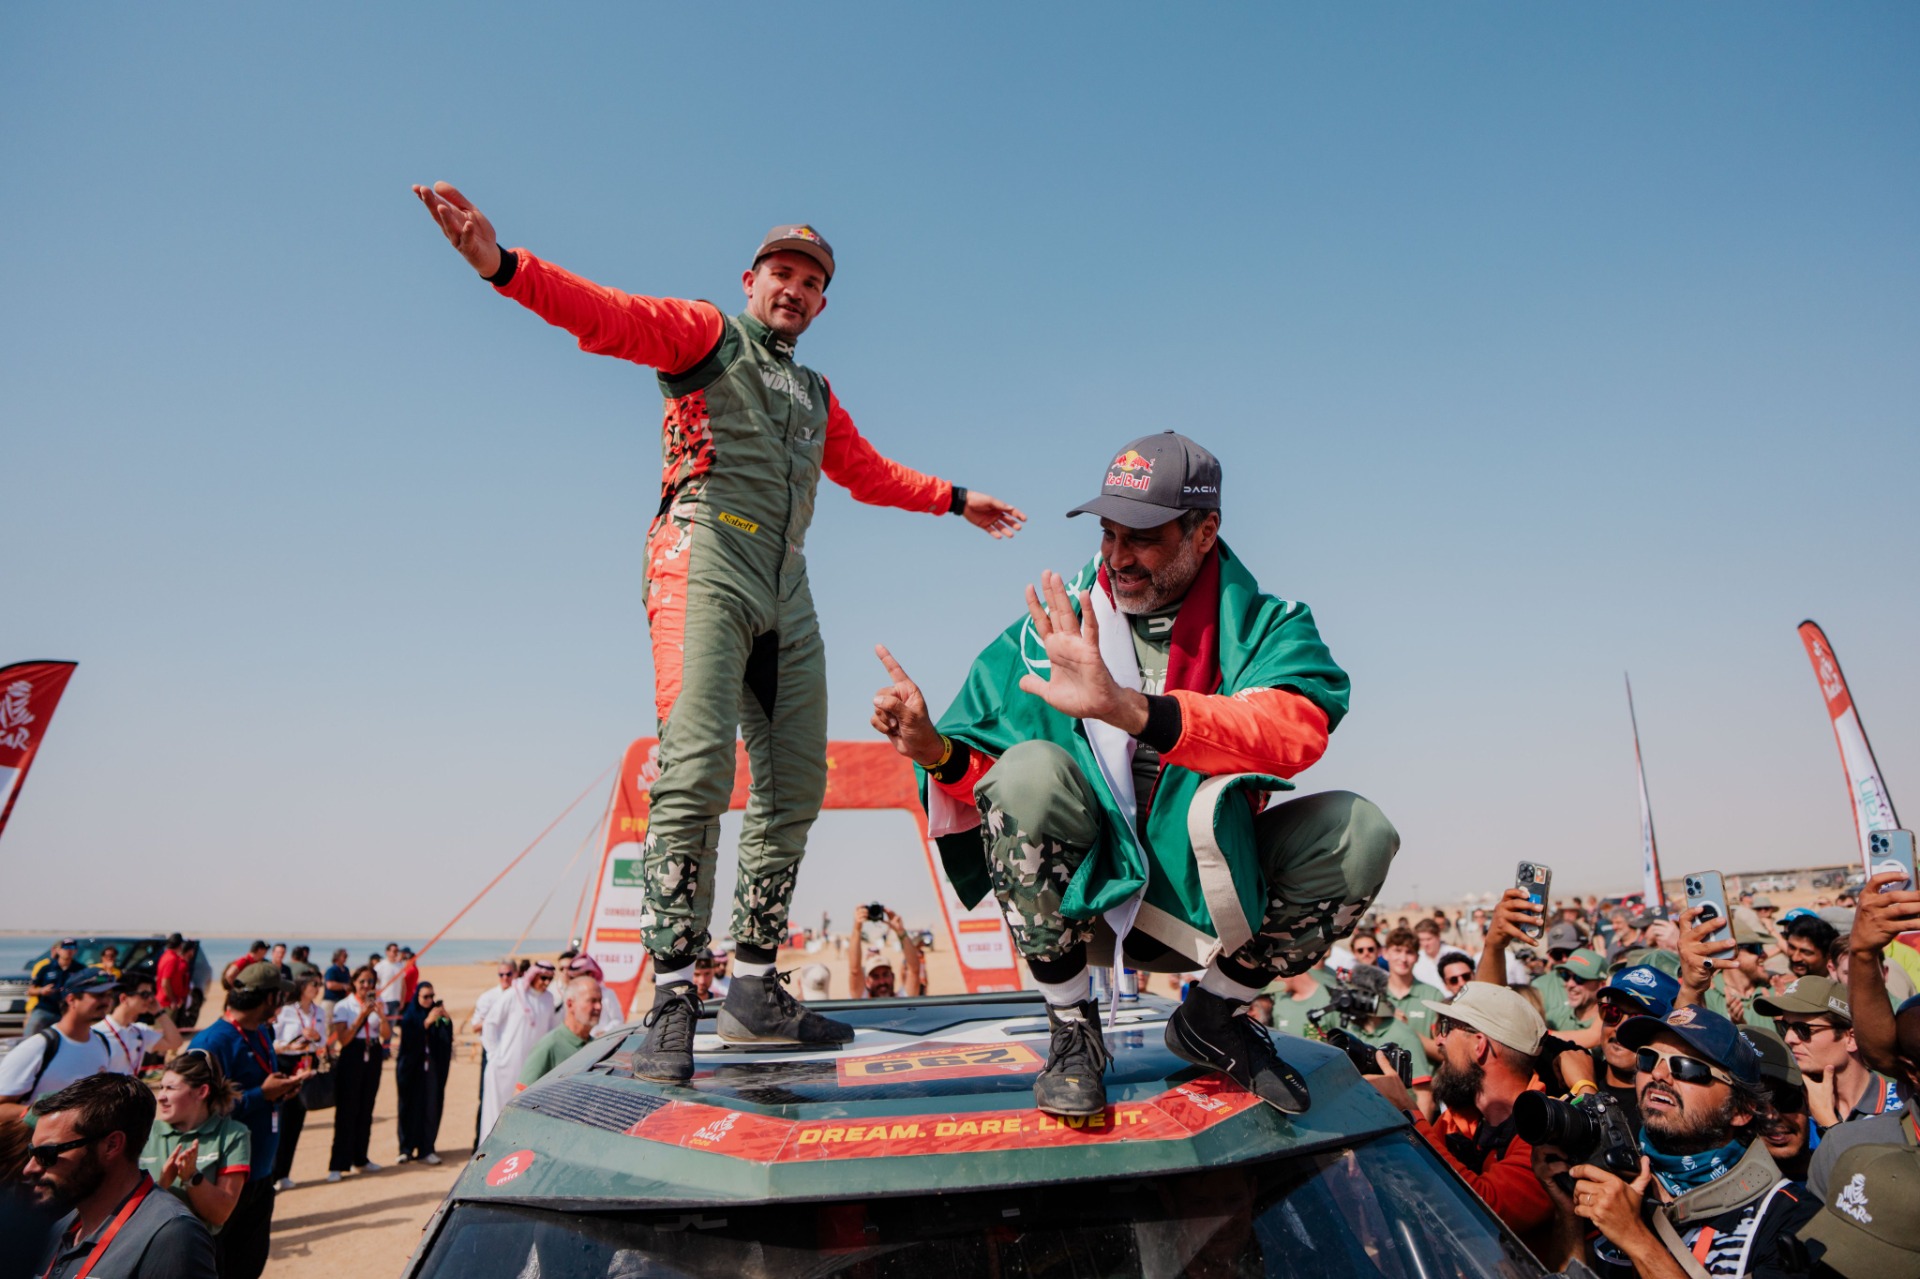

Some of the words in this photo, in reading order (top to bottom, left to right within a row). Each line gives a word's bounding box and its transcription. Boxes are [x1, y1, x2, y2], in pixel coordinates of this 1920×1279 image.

[1105, 471, 1124, 486] Red
[1123, 472, 1151, 491] Bull
[1183, 486, 1217, 494] DACIA
[722, 514, 754, 531] Sabelt
[798, 1123, 927, 1144] DREAM.
[935, 1118, 1031, 1137] DARE.
[1038, 1113, 1106, 1131] LIVE
[1114, 1110, 1149, 1126] IT.
[502, 1156, 519, 1174] 3
[496, 1171, 519, 1186] min
[1835, 1192, 1867, 1223] DAKAR
